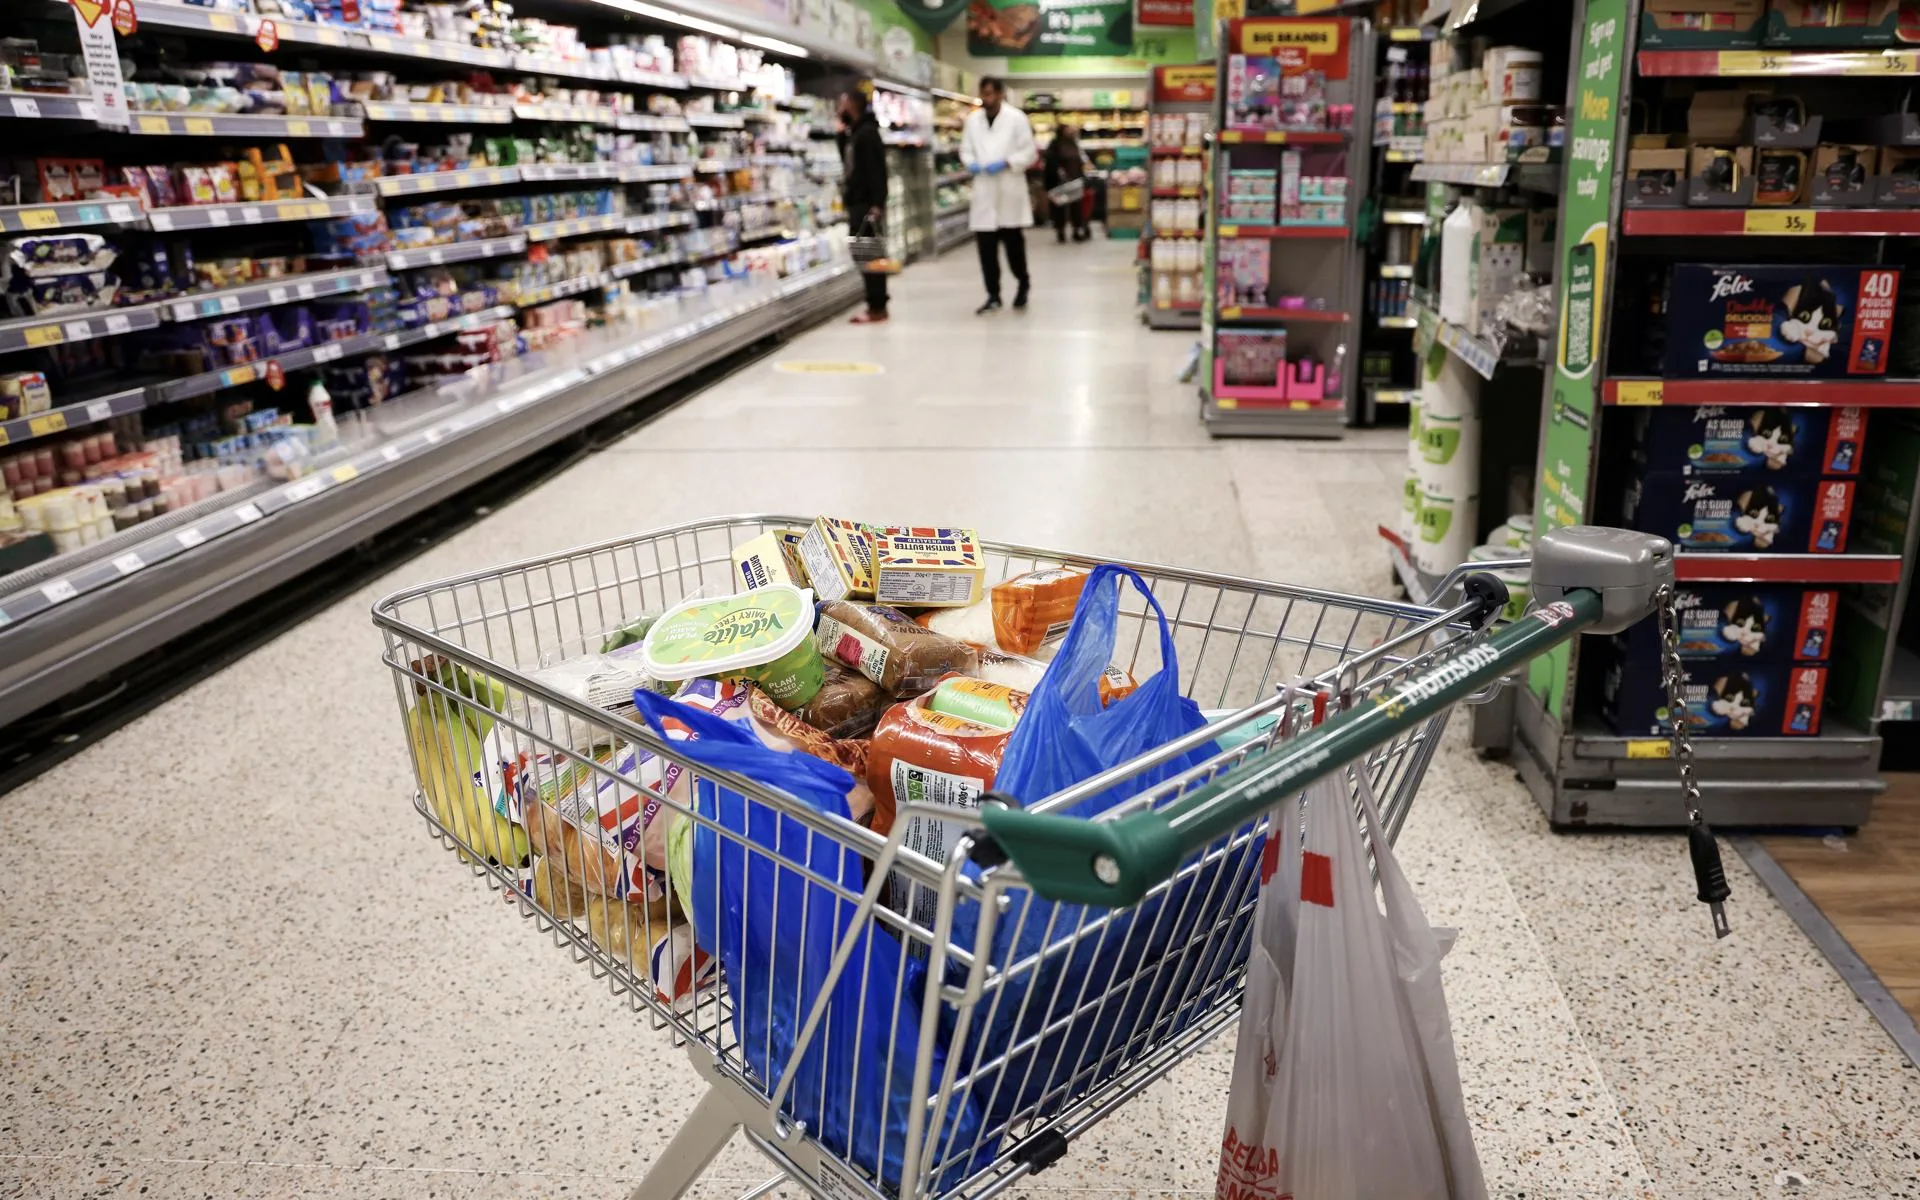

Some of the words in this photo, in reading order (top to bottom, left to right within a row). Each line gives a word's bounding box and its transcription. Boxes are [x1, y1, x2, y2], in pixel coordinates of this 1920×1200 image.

[1253, 31, 1274, 43] BIG
[1277, 31, 1328, 43] BRANDS
[1760, 57, 1783, 70] 35p
[1885, 56, 1907, 71] 35p
[1581, 89, 1609, 120] More
[1572, 128, 1610, 172] savings
[1577, 172, 1598, 200] today
[1785, 215, 1807, 231] 35p
[1864, 273, 1893, 297] 40
[1861, 319, 1885, 330] PACK
[1827, 482, 1847, 499] 40
[894, 543, 924, 552] BUTTER
[928, 543, 957, 552] BRITISH
[749, 554, 765, 580] BRITISH
[1811, 593, 1829, 607] 40
[713, 615, 738, 629] FREE
[738, 609, 767, 621] DAIRY
[704, 612, 784, 646] Vitalite
[769, 674, 797, 690] PLANT
[1396, 642, 1500, 706] Morrisons
[1800, 669, 1818, 685] 40
[774, 683, 797, 695] BASED
[644, 802, 657, 817] 10
[667, 766, 679, 781] 10
